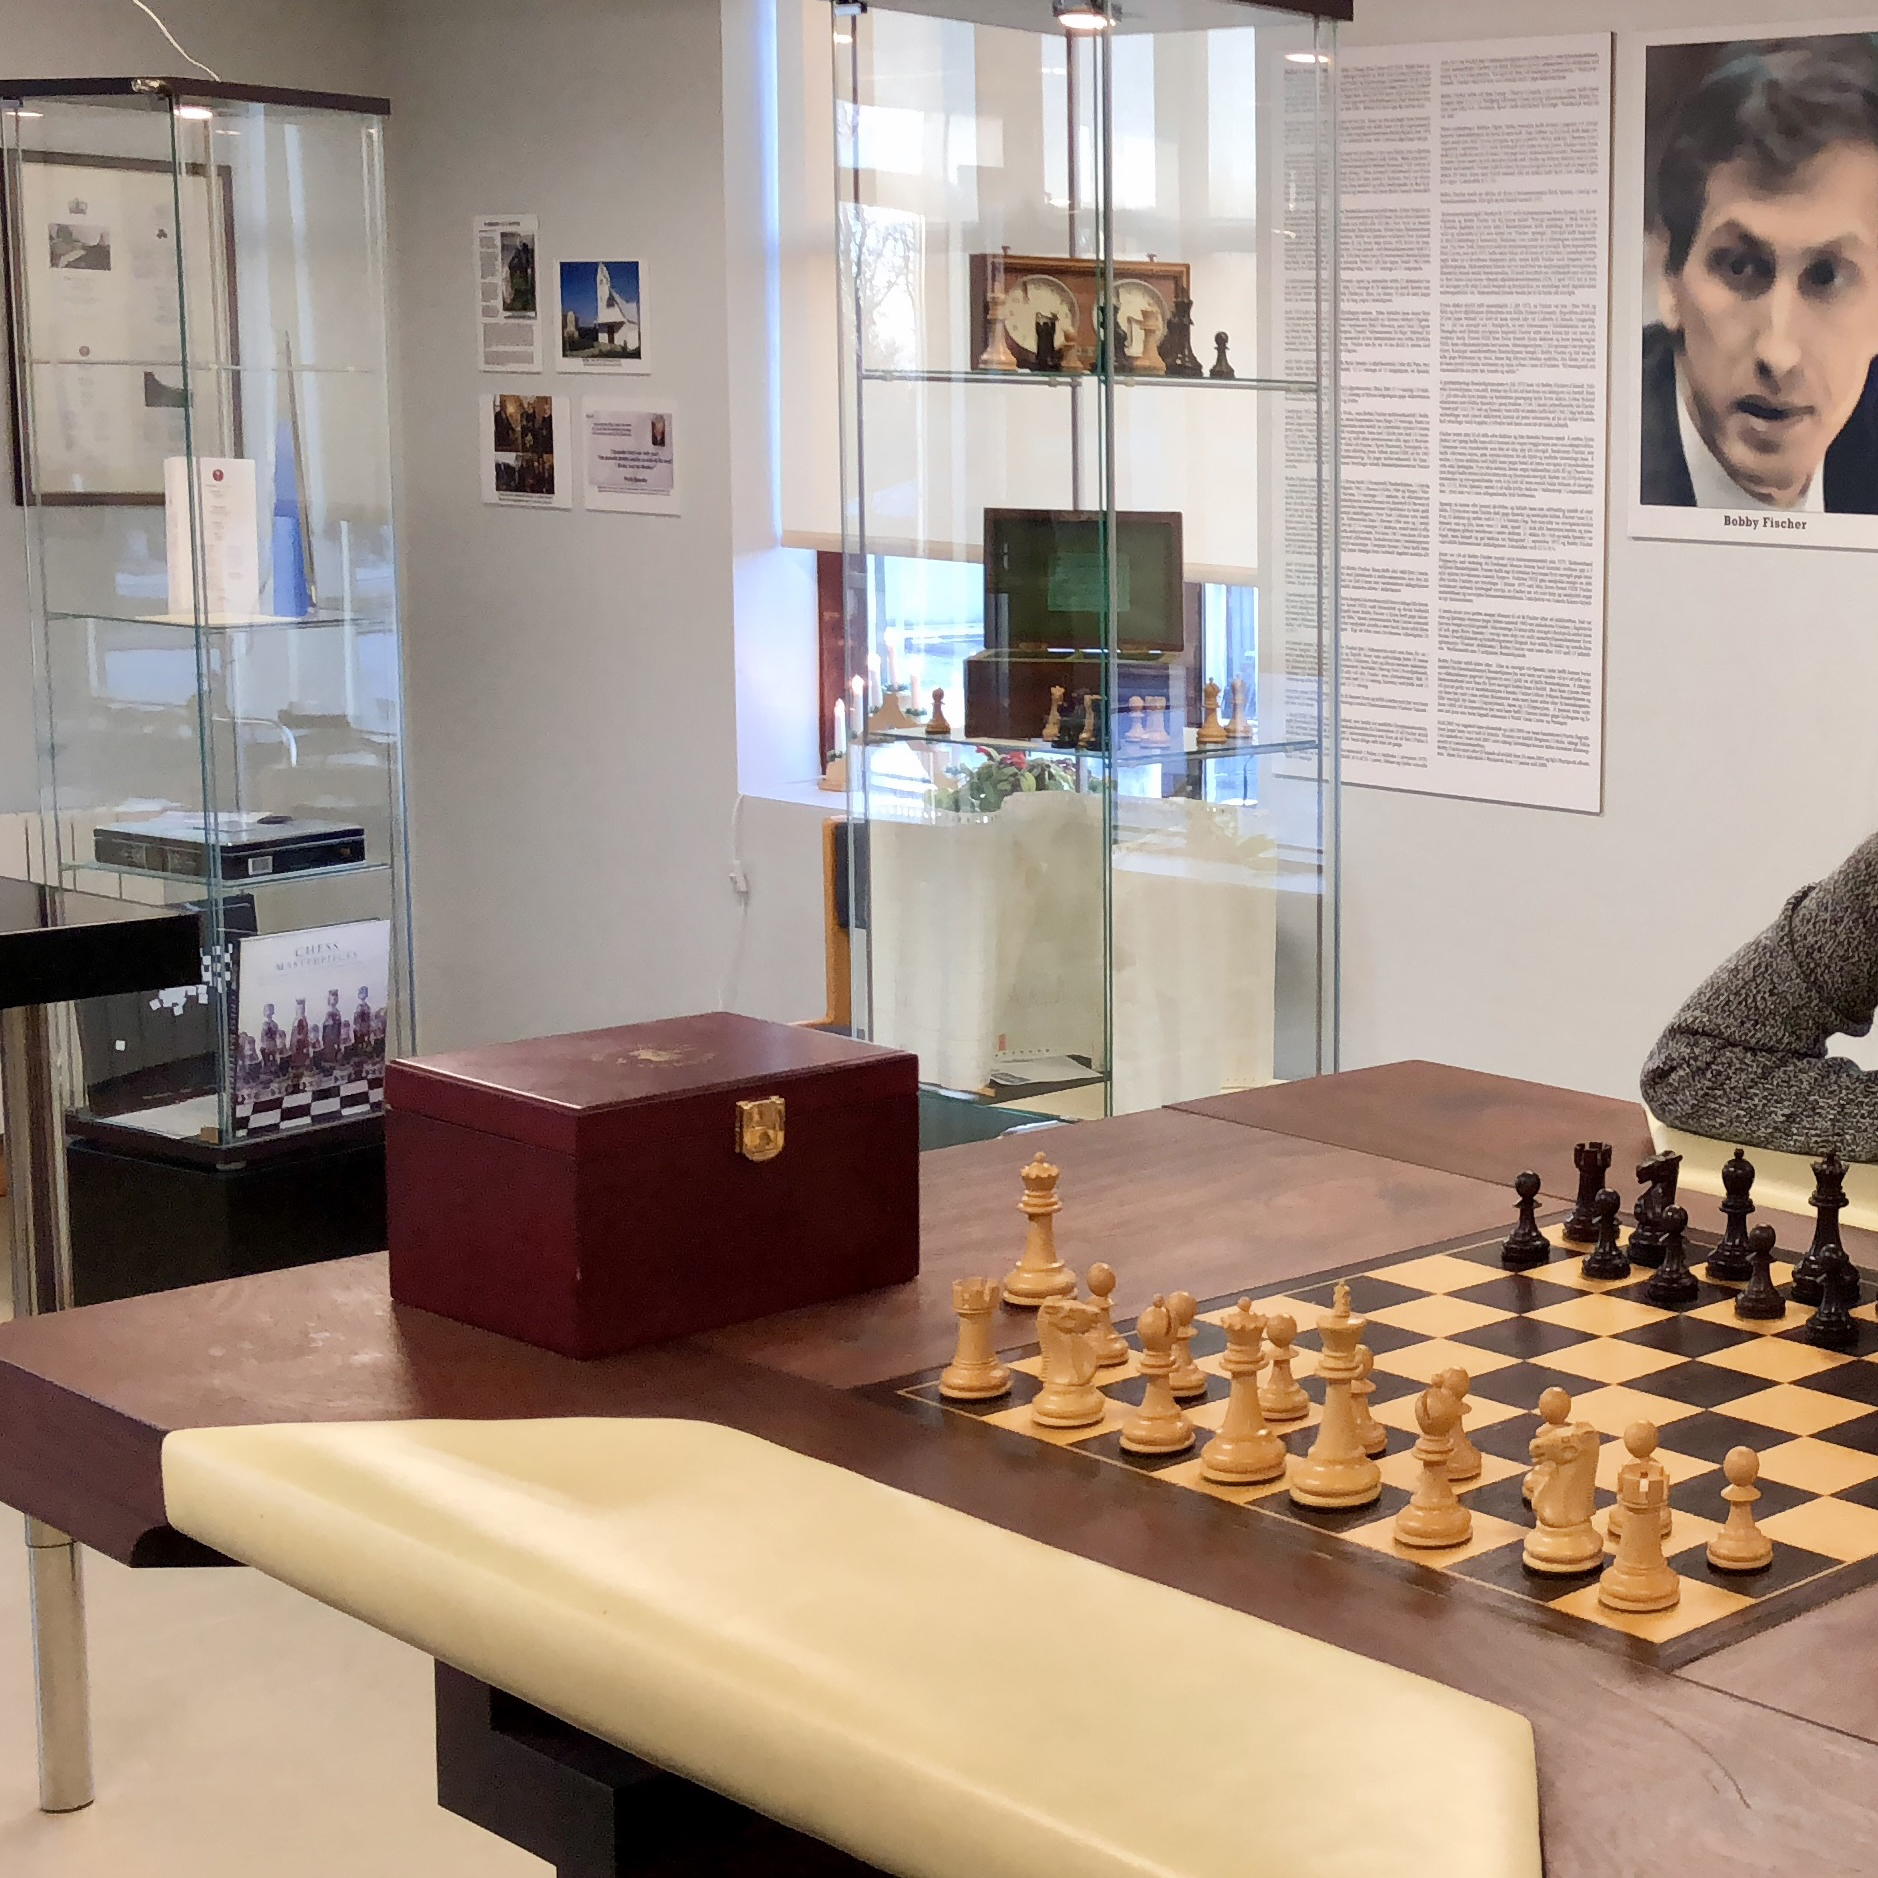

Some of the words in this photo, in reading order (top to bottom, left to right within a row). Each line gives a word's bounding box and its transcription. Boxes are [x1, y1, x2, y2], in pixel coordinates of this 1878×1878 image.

[1723, 514, 1759, 530] Bobby
[1762, 516, 1808, 530] Fischer
[295, 942, 340, 957] CHESS
